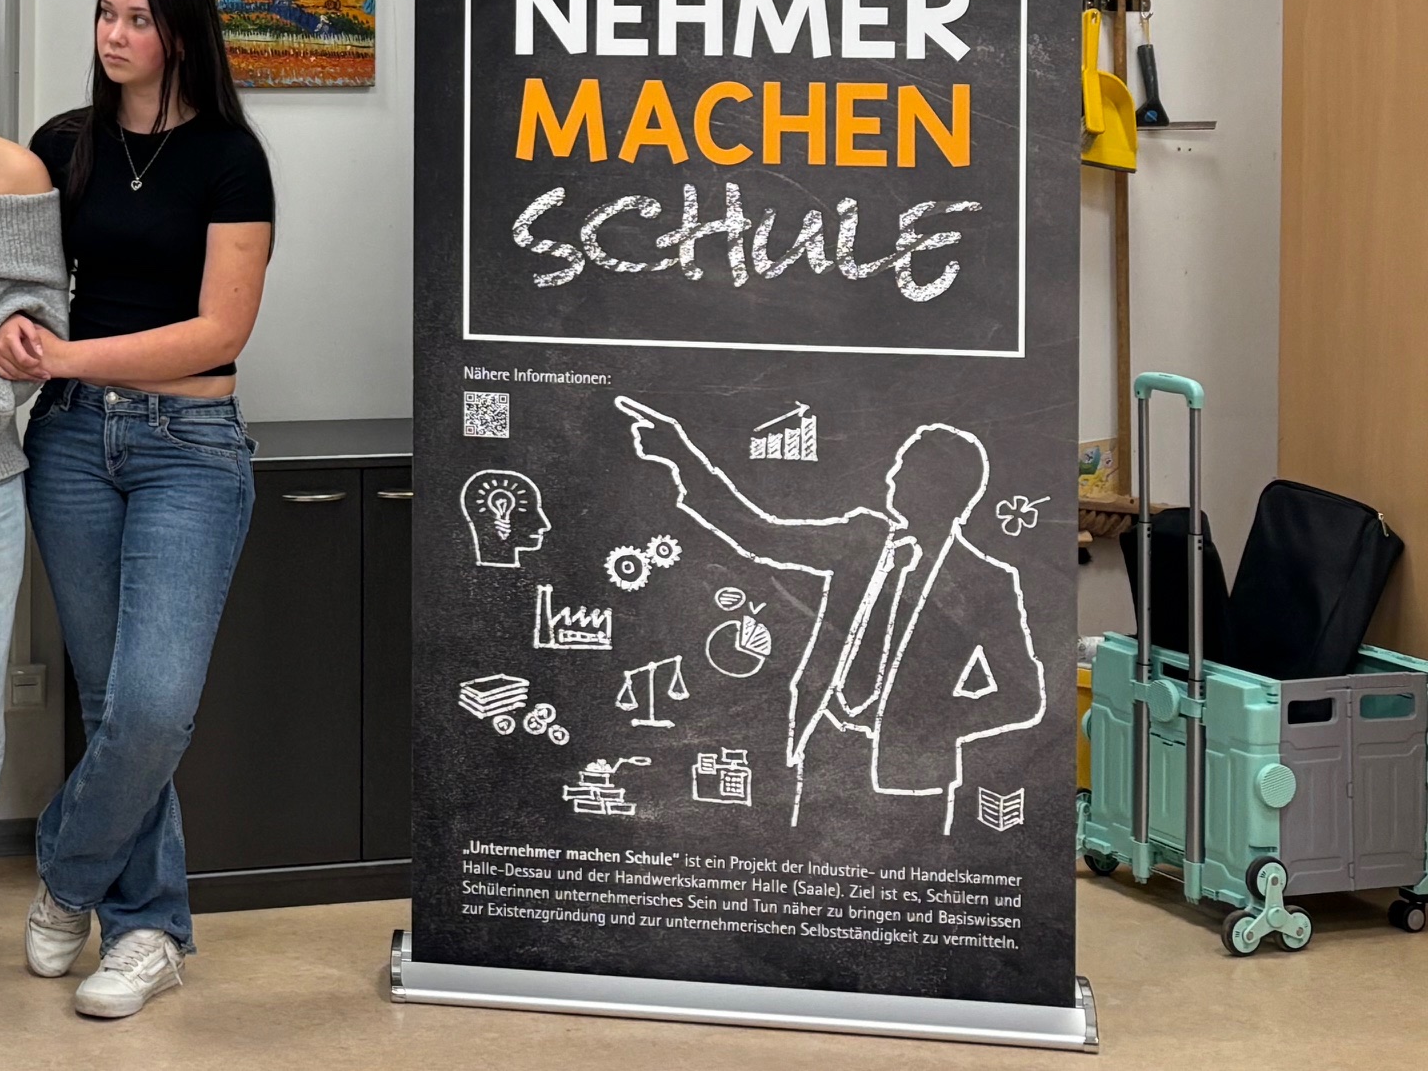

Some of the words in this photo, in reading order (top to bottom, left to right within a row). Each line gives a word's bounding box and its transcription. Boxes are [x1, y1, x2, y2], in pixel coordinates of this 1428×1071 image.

[515, 77, 971, 167] MACHEN
[464, 366, 510, 381] Nähere
[514, 368, 611, 384] Informationen:
[463, 840, 561, 860] „Unternehmer
[566, 848, 620, 863] machen
[685, 854, 701, 868] ist
[705, 855, 725, 869] ein
[730, 856, 777, 874] Projekt
[782, 860, 803, 873] der
[808, 861, 875, 878] Industrie-
[880, 867, 906, 880] und
[911, 867, 1022, 887] Handelskammer
[463, 860, 551, 879] Halle-Dessau
[558, 868, 582, 881] und
[588, 869, 610, 882] der
[615, 870, 747, 891] Handwerkskammer
[752, 879, 787, 893] Halle
[793, 880, 844, 898] (Saale).
[850, 885, 874, 900] Ziel
[881, 887, 898, 901] ist
[903, 890, 921, 904] es,
[927, 889, 989, 905] Schülern
[995, 894, 1021, 908] und
[462, 880, 549, 899] Schülerinnen
[555, 889, 683, 907] unternehmerisches
[688, 895, 717, 910] Sein
[722, 898, 747, 912] und
[753, 899, 777, 913] Tun
[783, 902, 822, 916] näher
[827, 907, 842, 918] zu
[849, 906, 901, 924] bringen
[907, 910, 933, 923] und
[939, 911, 1021, 928] Basiswissen
[462, 904, 483, 915] zur
[488, 903, 605, 926] Existenzgründung
[611, 913, 635, 925] und
[640, 915, 662, 927] zur
[666, 916, 796, 935] unternehmerischen
[800, 923, 918, 945] Selbstständigkeit
[923, 934, 938, 944] zu
[943, 933, 1019, 949] vermitteln.
